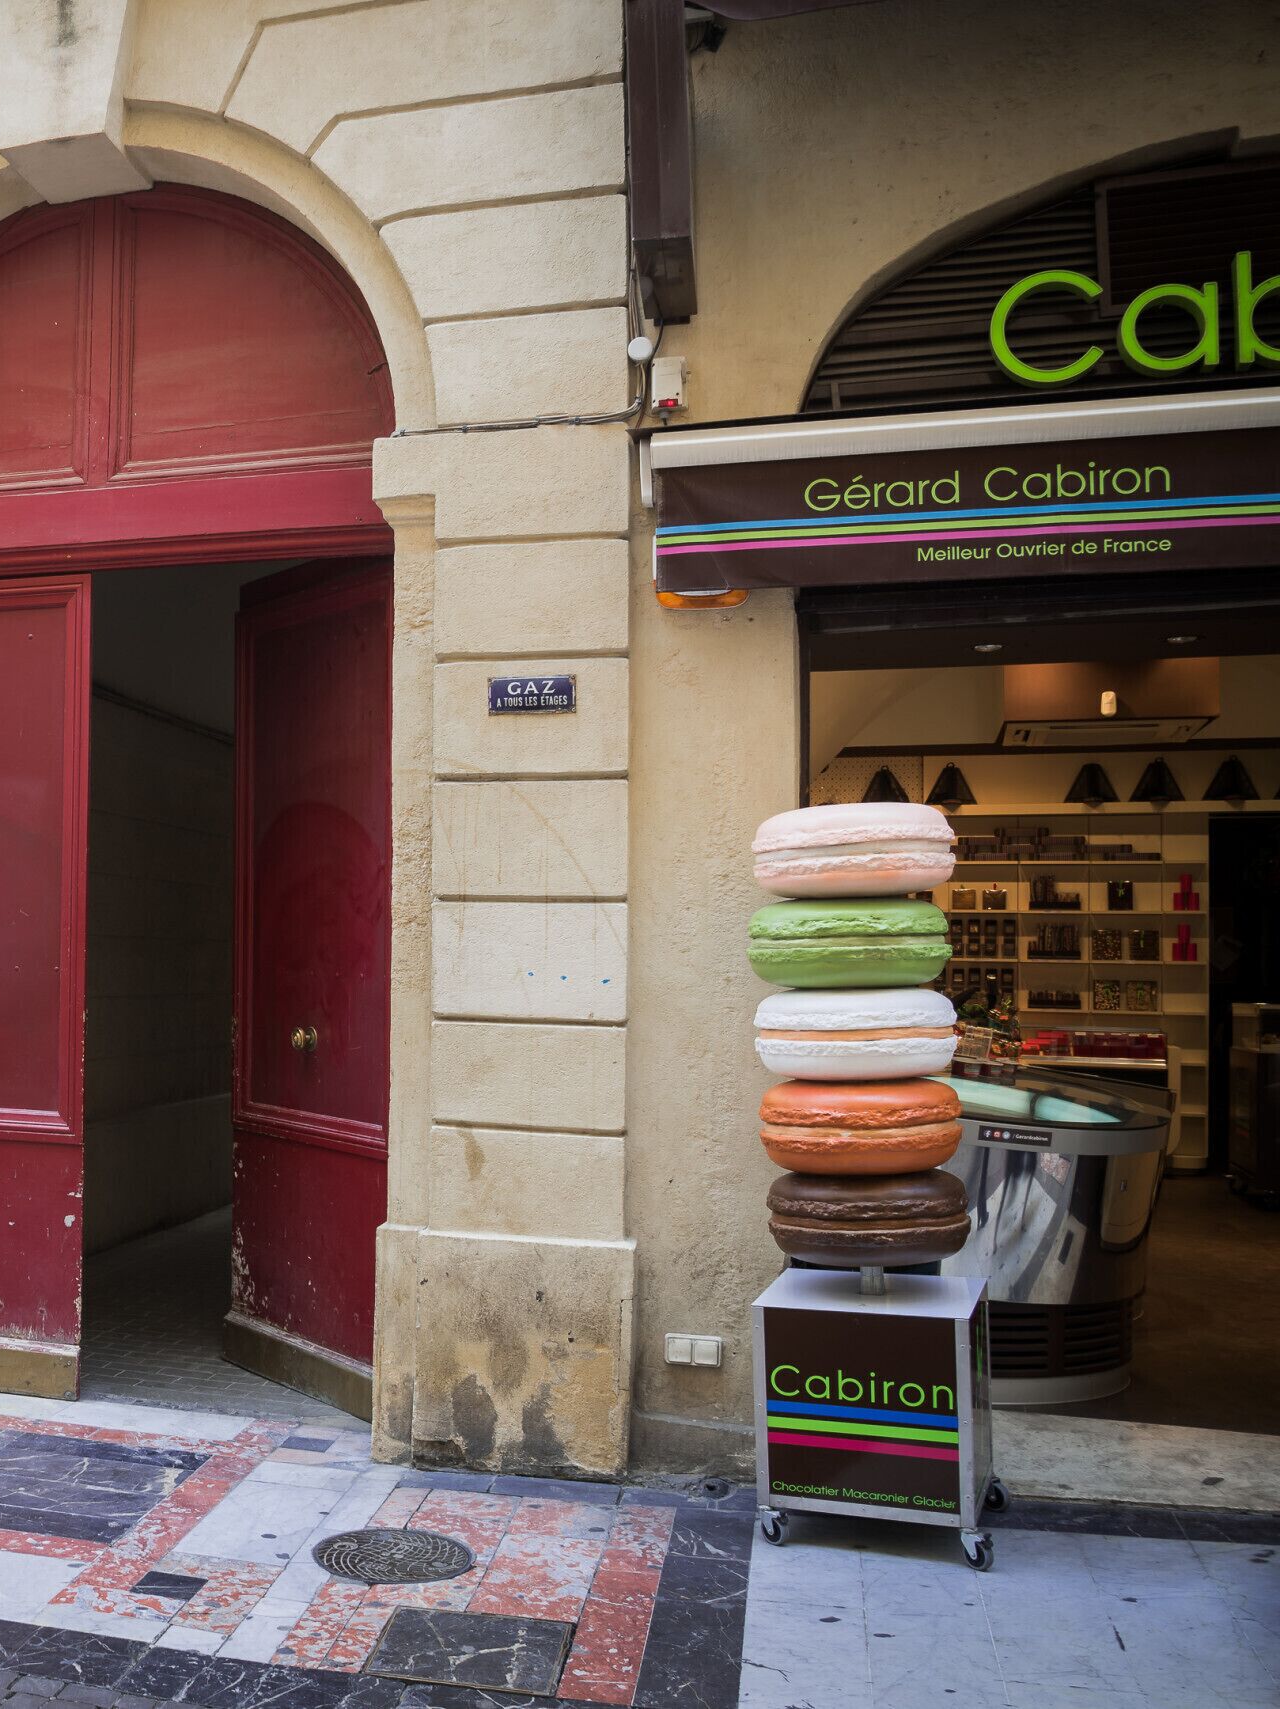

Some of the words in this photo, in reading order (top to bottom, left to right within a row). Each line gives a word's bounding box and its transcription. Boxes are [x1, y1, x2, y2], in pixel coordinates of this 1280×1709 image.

[804, 470, 960, 512] Gérard
[983, 461, 1172, 502] Cabiron
[916, 544, 991, 562] Meilleur
[996, 540, 1066, 559] Ouvrier
[1071, 538, 1098, 555] de
[1103, 536, 1172, 554] France
[503, 697, 523, 707] TOUS
[524, 696, 538, 707] LES
[507, 680, 556, 695] GAZ
[770, 1364, 954, 1410] Cabiron
[772, 1480, 839, 1497] Chocolatier
[842, 1487, 910, 1504] Macaronier
[913, 1495, 957, 1510] Glacier
